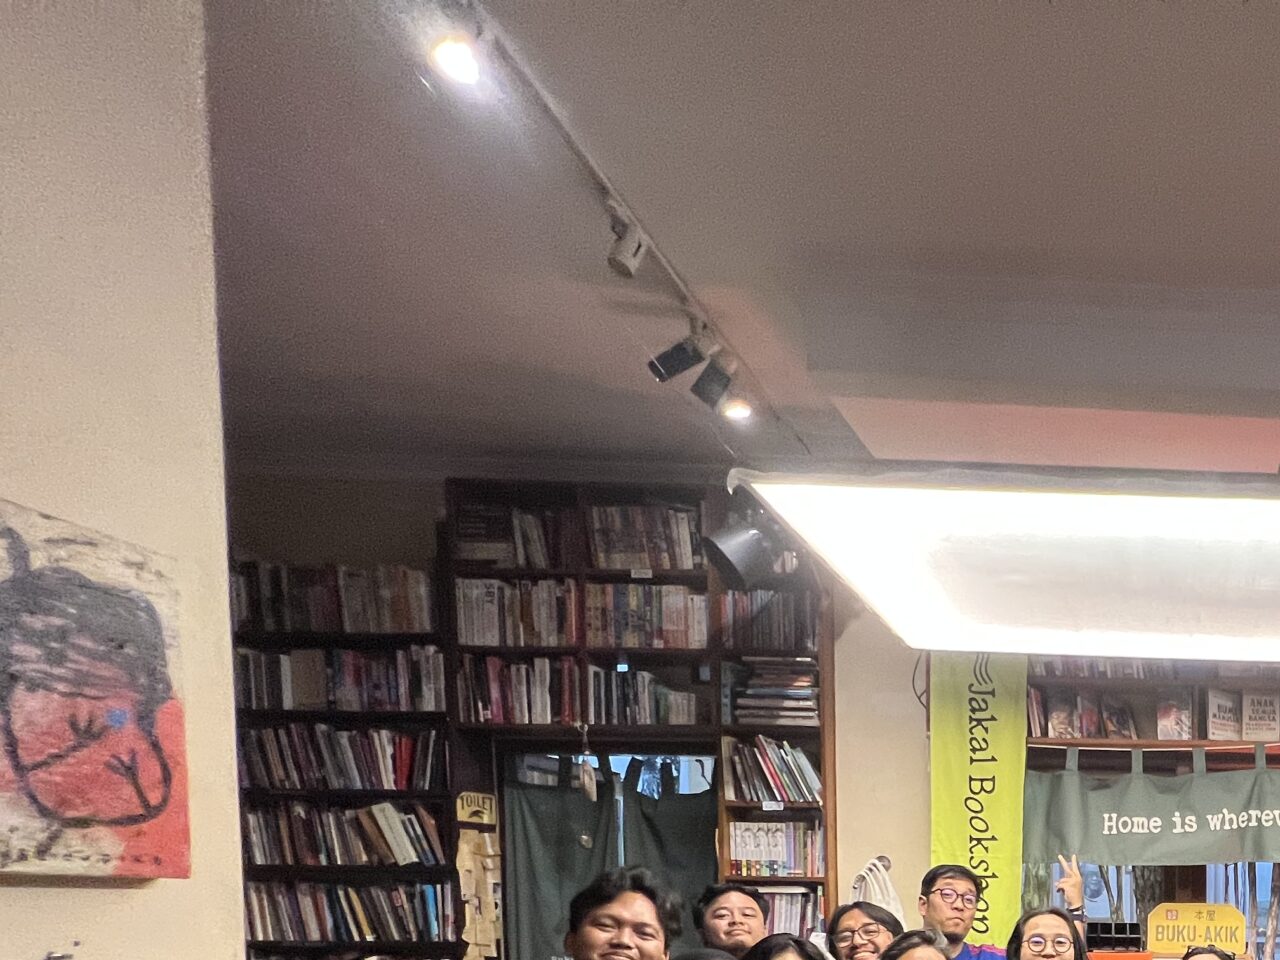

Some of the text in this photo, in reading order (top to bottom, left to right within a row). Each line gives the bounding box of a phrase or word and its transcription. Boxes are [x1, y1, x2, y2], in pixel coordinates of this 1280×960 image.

[968, 683, 998, 765] Jakal
[461, 794, 493, 814] TOILET
[1102, 812, 1162, 835] Home
[1171, 811, 1198, 834] is
